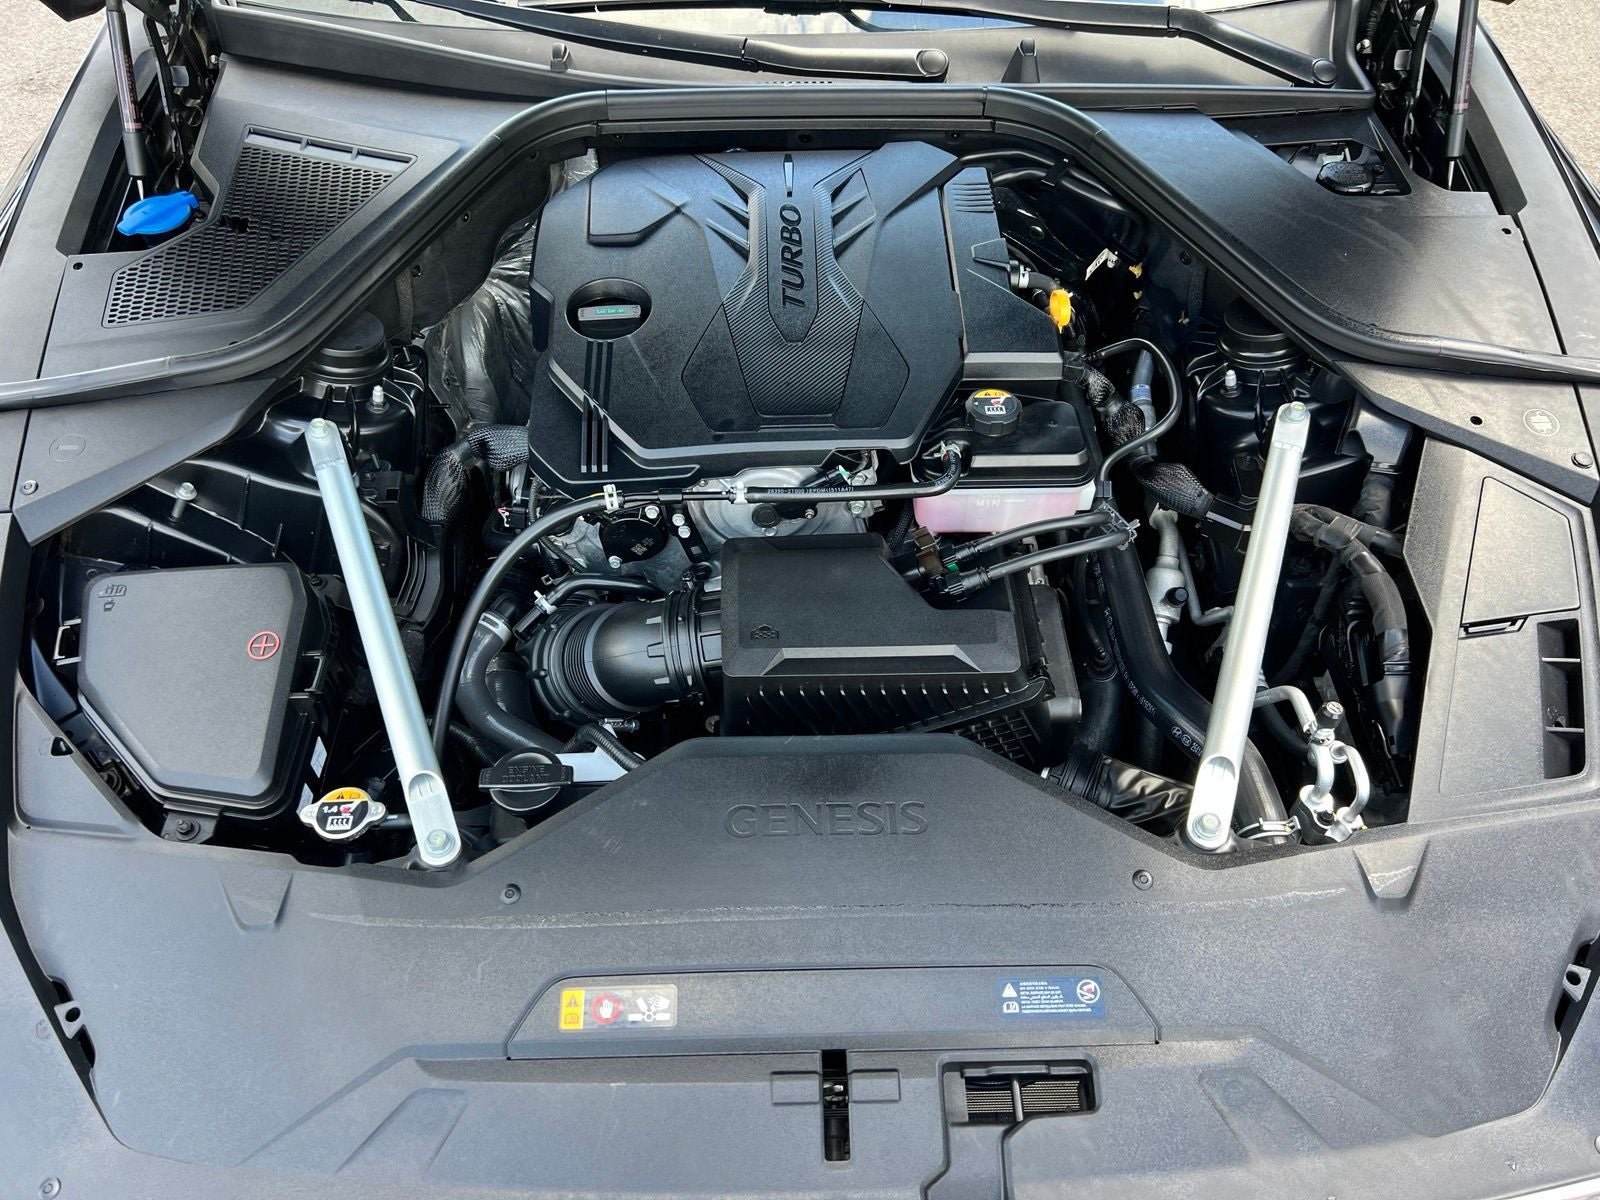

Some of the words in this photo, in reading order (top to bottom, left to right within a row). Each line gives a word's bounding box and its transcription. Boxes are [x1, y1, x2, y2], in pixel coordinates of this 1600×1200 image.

[779, 203, 805, 308] TURBO
[508, 765, 545, 774] ENGINE
[501, 774, 550, 784] COOLANT
[322, 805, 339, 814] 1.4
[724, 801, 929, 839] GENESIS
